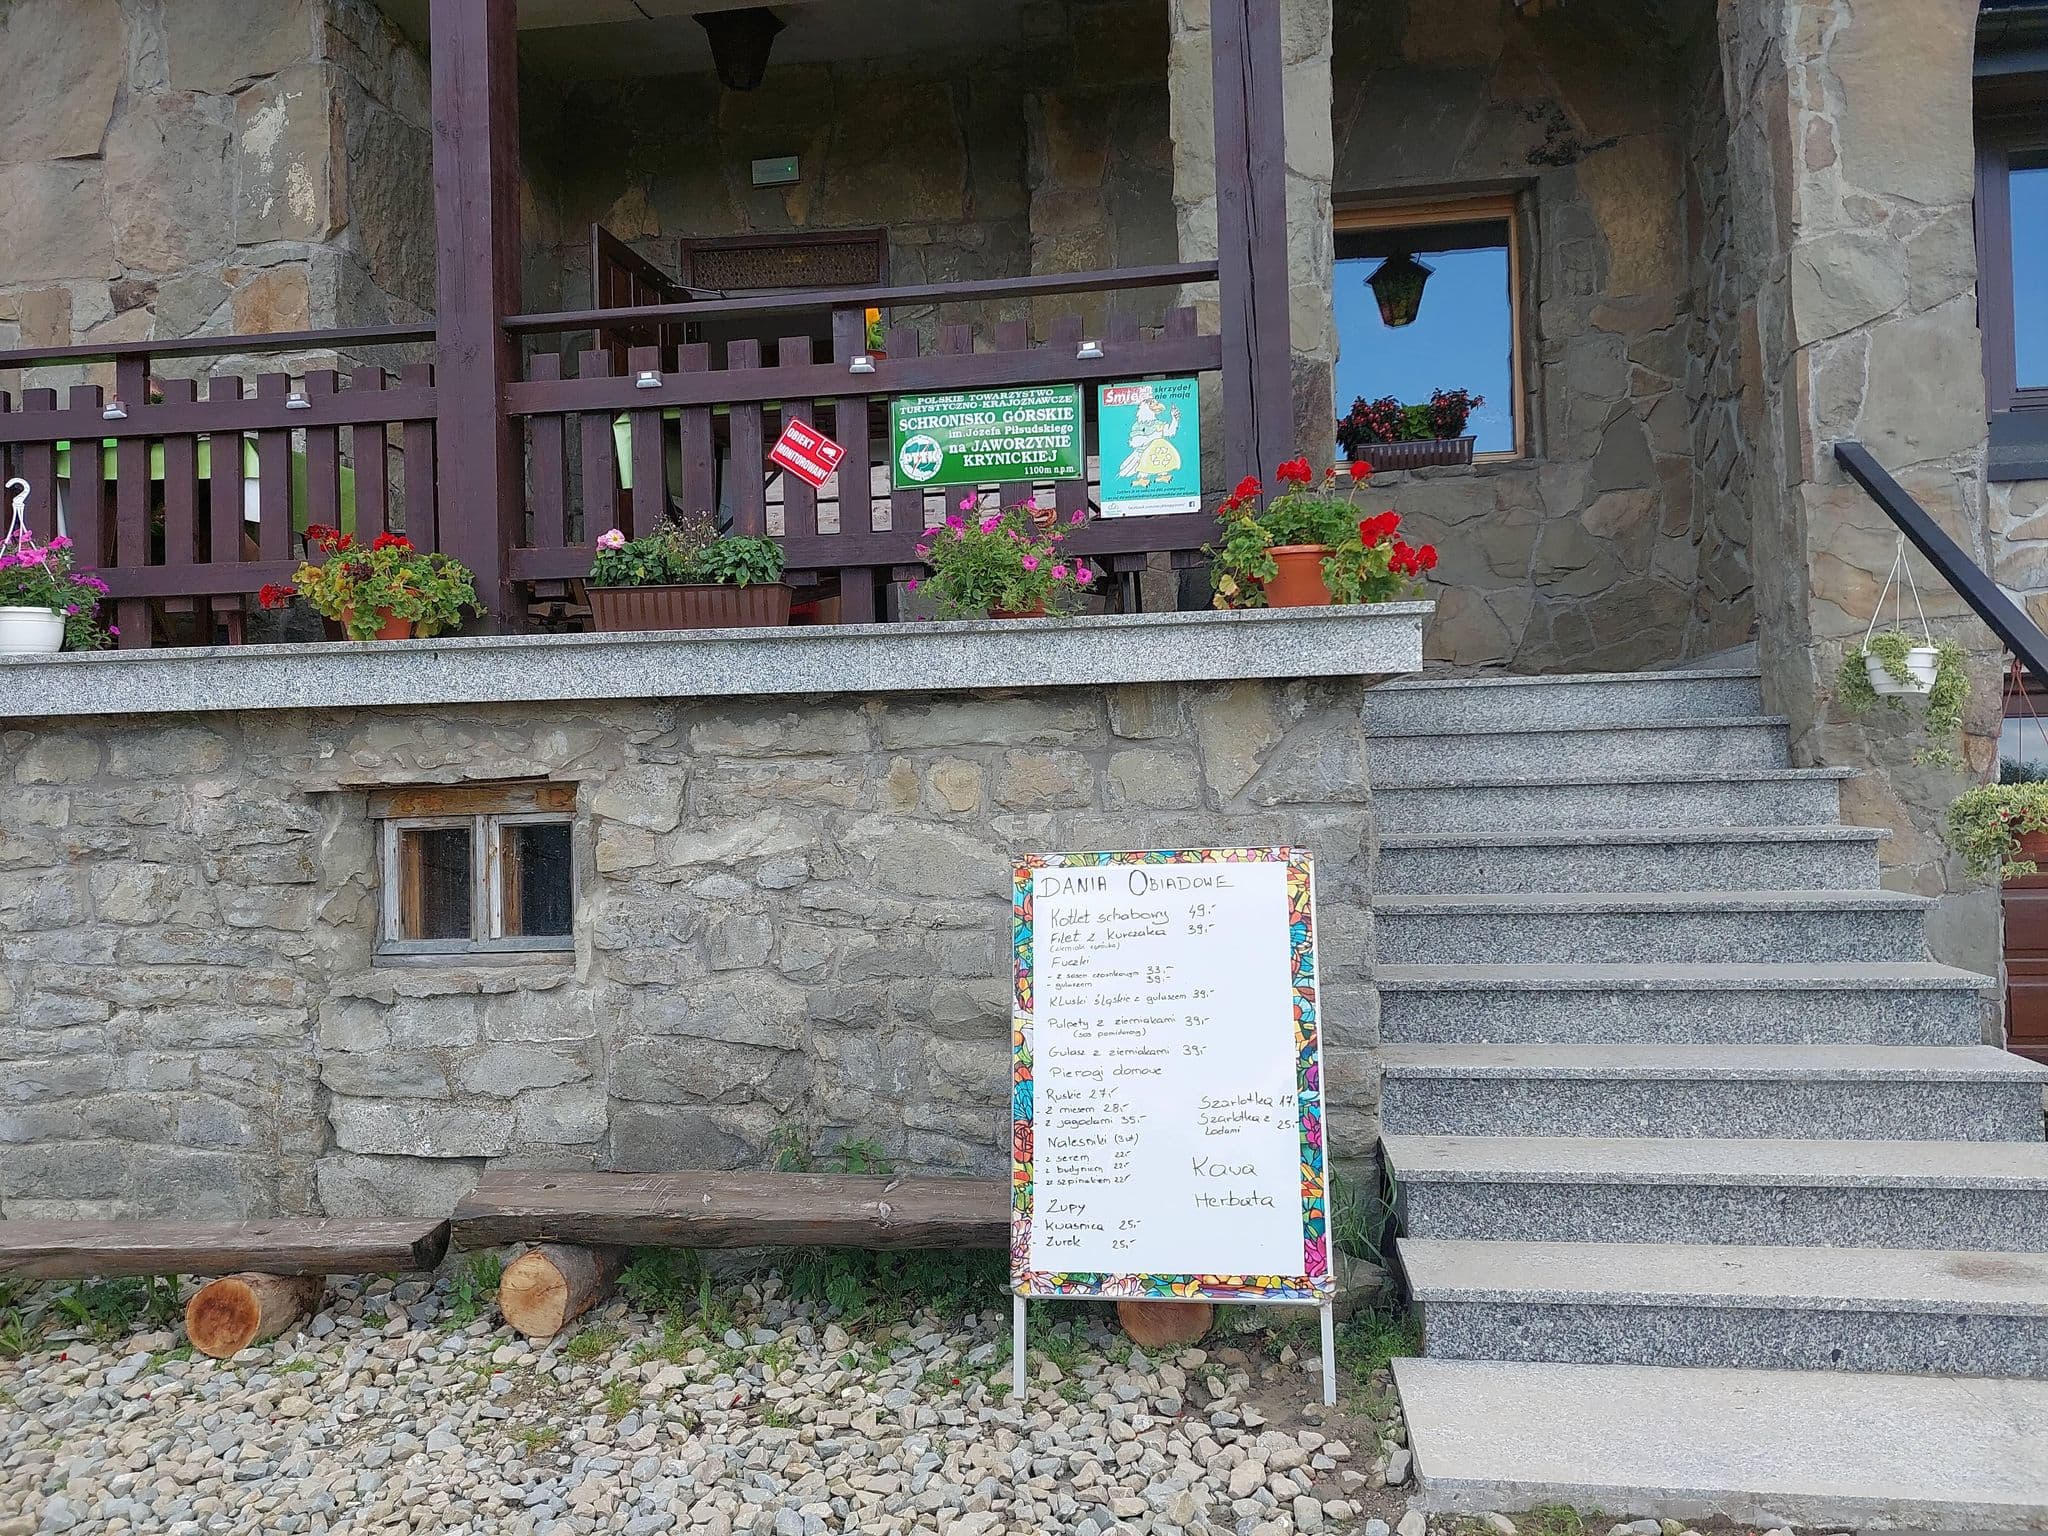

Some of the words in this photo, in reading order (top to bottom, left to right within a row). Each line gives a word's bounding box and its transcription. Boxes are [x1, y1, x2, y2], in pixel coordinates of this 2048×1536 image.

[899, 395, 1073, 415] TURYSTYCZNO-KRAJOZNAWCZE
[918, 395, 965, 405] POLSKIE
[969, 389, 1054, 401] TOWARZYSTWO
[899, 411, 996, 432] SCHRONISKO
[1003, 406, 1074, 422] GÓRSKIE
[1005, 424, 1073, 436] Piłsudskiego
[786, 428, 815, 450] OBIEKT
[948, 443, 966, 454] na
[971, 435, 1072, 453] JAWORZYNIE
[776, 443, 828, 480] MONITOROWANY
[963, 450, 1058, 467] KRYNICKIEJ
[1024, 466, 1052, 475] 1100m
[1036, 876, 1107, 899] DANIA
[1050, 908, 1090, 928] Kotlet
[1096, 907, 1170, 926] schabowy
[1048, 1017, 1089, 1030] Pulpety
[1048, 1046, 1086, 1058] Gulasz
[1048, 1066, 1104, 1081] Pierogi
[1112, 1063, 1163, 1076] domowe
[1046, 1088, 1082, 1103] Ruskie
[1198, 1092, 1273, 1110] Szarlotka
[1057, 1116, 1113, 1129] jagodami
[1197, 1110, 1261, 1125] Szarlotka
[1056, 1154, 1090, 1163] serem
[1192, 1156, 1258, 1177] Kawa
[1057, 1164, 1104, 1175] budyniem
[1195, 1189, 1276, 1208] Herbata
[1046, 1199, 1086, 1216] Zupy
